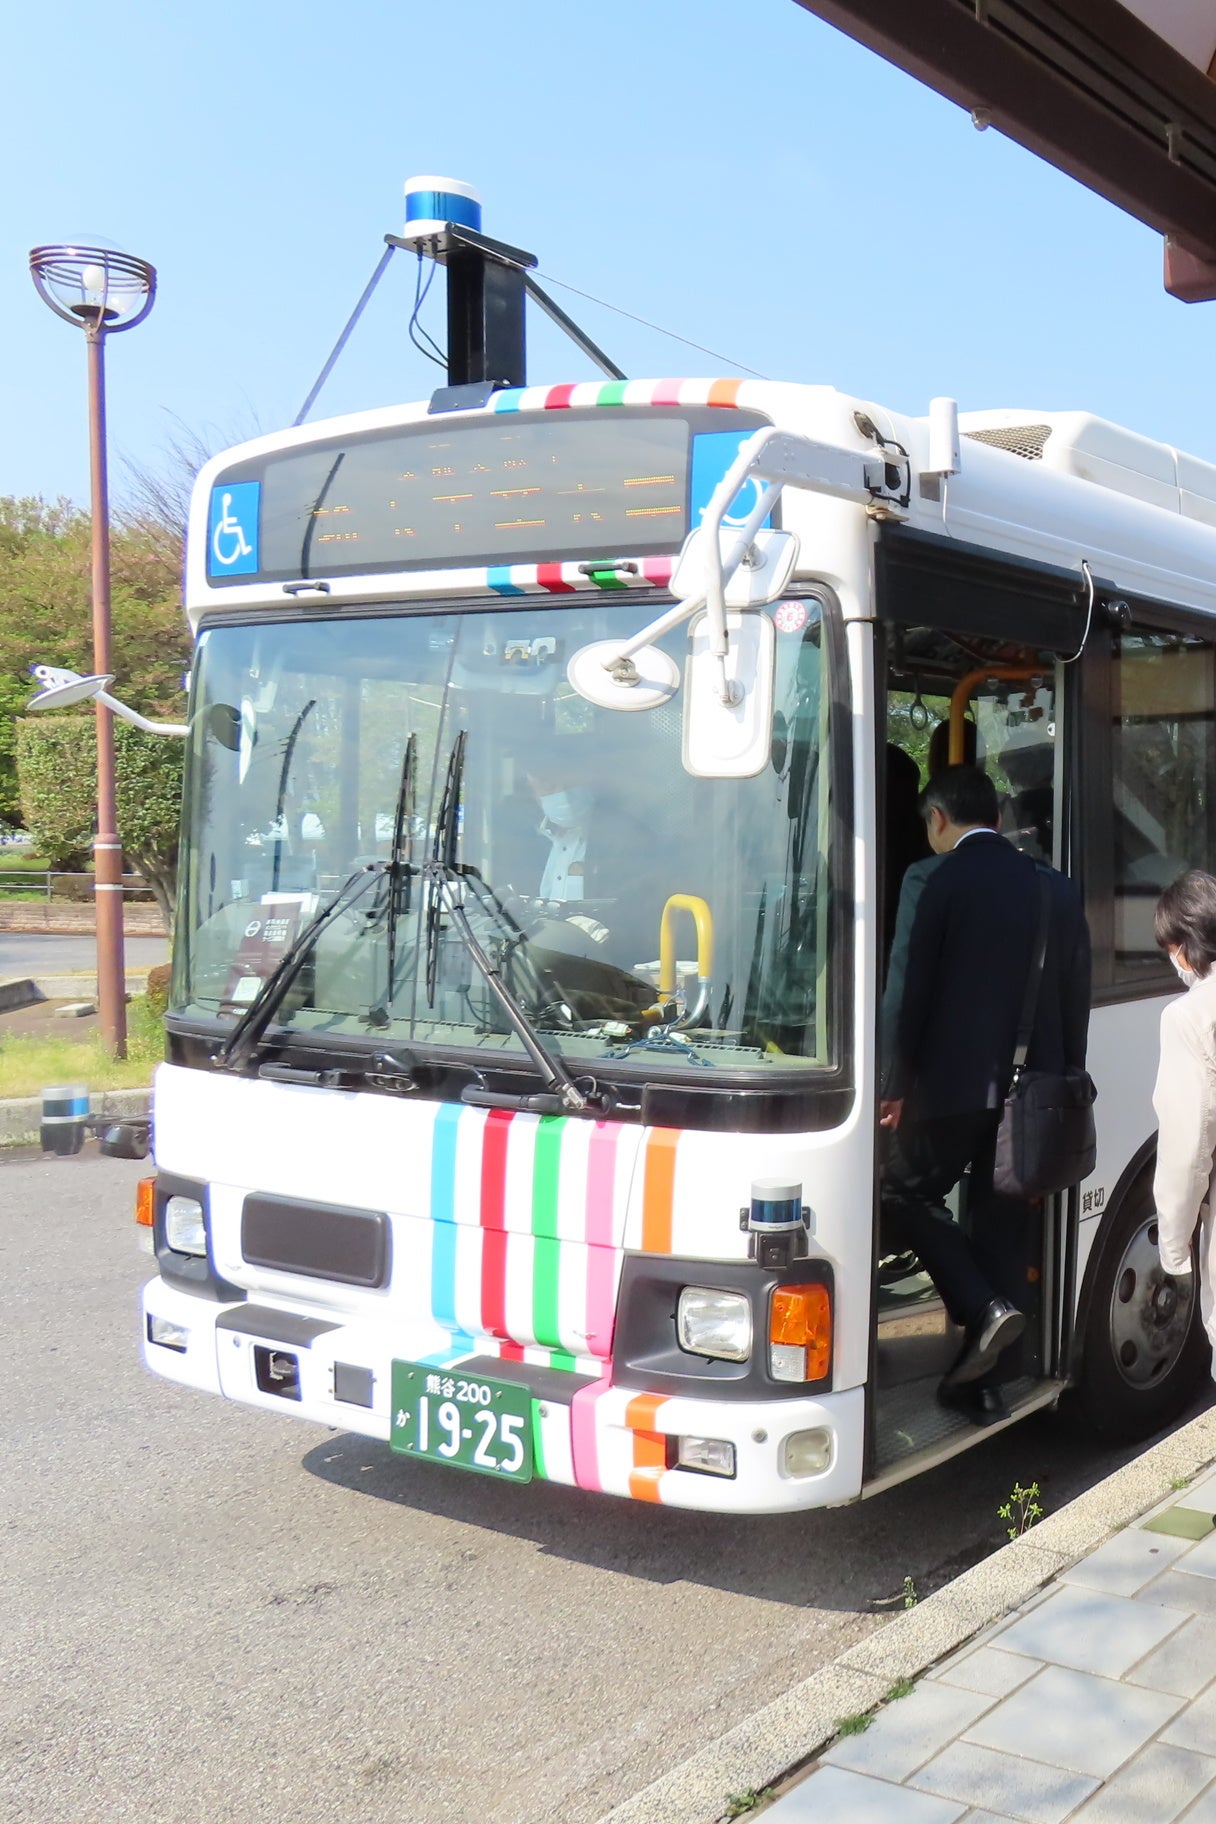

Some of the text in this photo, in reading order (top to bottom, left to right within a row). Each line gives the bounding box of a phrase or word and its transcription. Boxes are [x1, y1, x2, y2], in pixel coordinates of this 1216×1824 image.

[1083, 1188, 1104, 1213] 貸切
[396, 1396, 524, 1472] か 19-25
